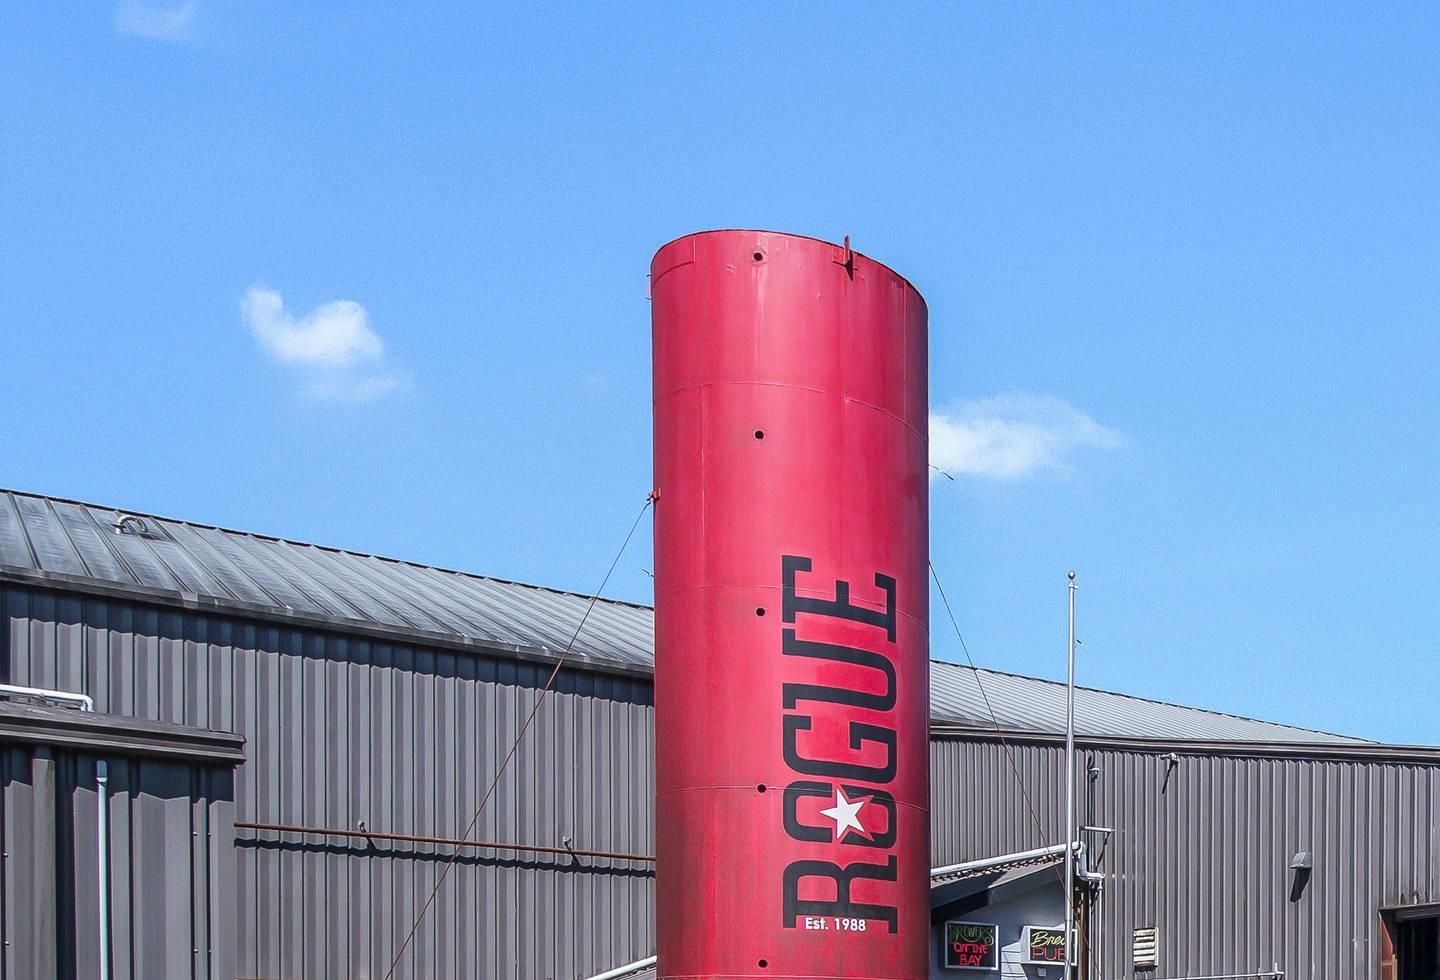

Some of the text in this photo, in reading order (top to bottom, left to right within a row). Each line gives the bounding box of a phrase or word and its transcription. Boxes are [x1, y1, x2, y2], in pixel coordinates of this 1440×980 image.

[781, 554, 898, 934] ROGUE
[805, 917, 866, 931] Est. 1988
[959, 953, 982, 966] BAY
